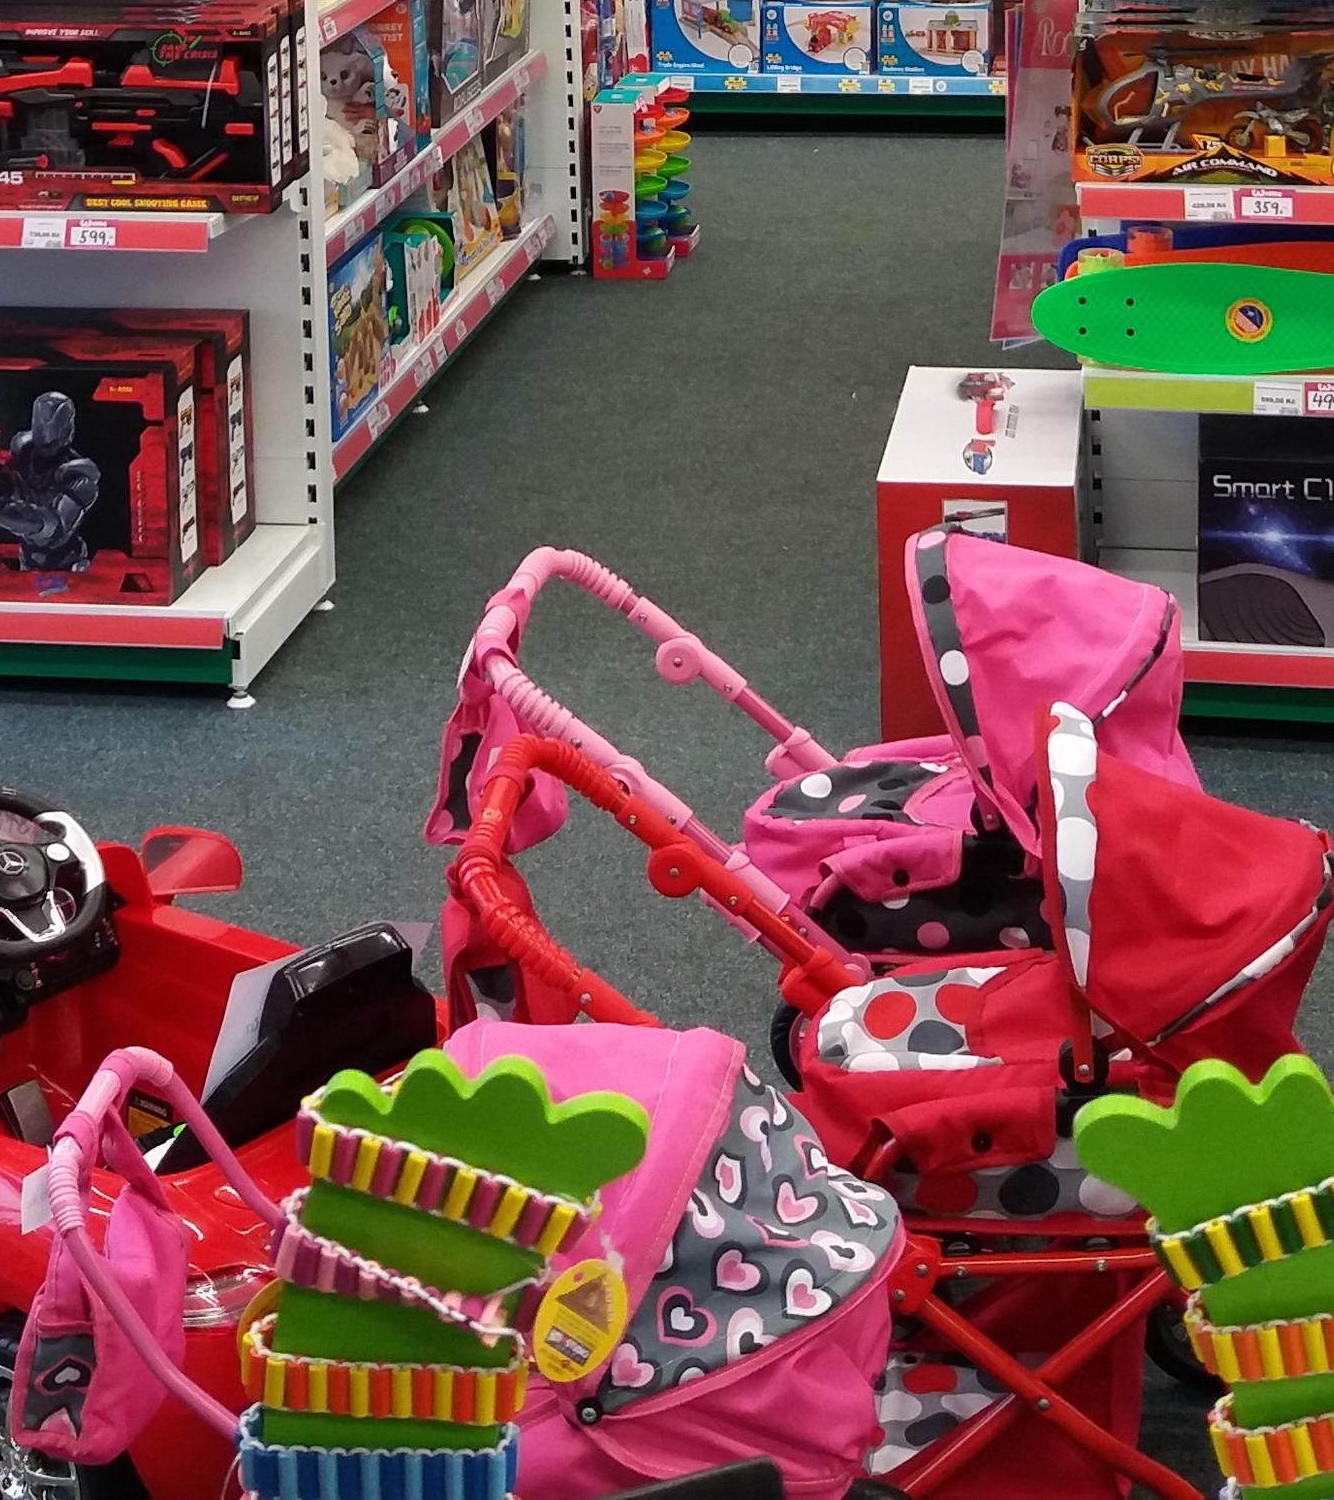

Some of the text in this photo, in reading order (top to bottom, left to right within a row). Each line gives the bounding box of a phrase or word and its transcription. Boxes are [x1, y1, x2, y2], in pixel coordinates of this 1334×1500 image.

[1172, 158, 1278, 179] AIR COMMAND
[1212, 474, 1334, 500] Smart C1
